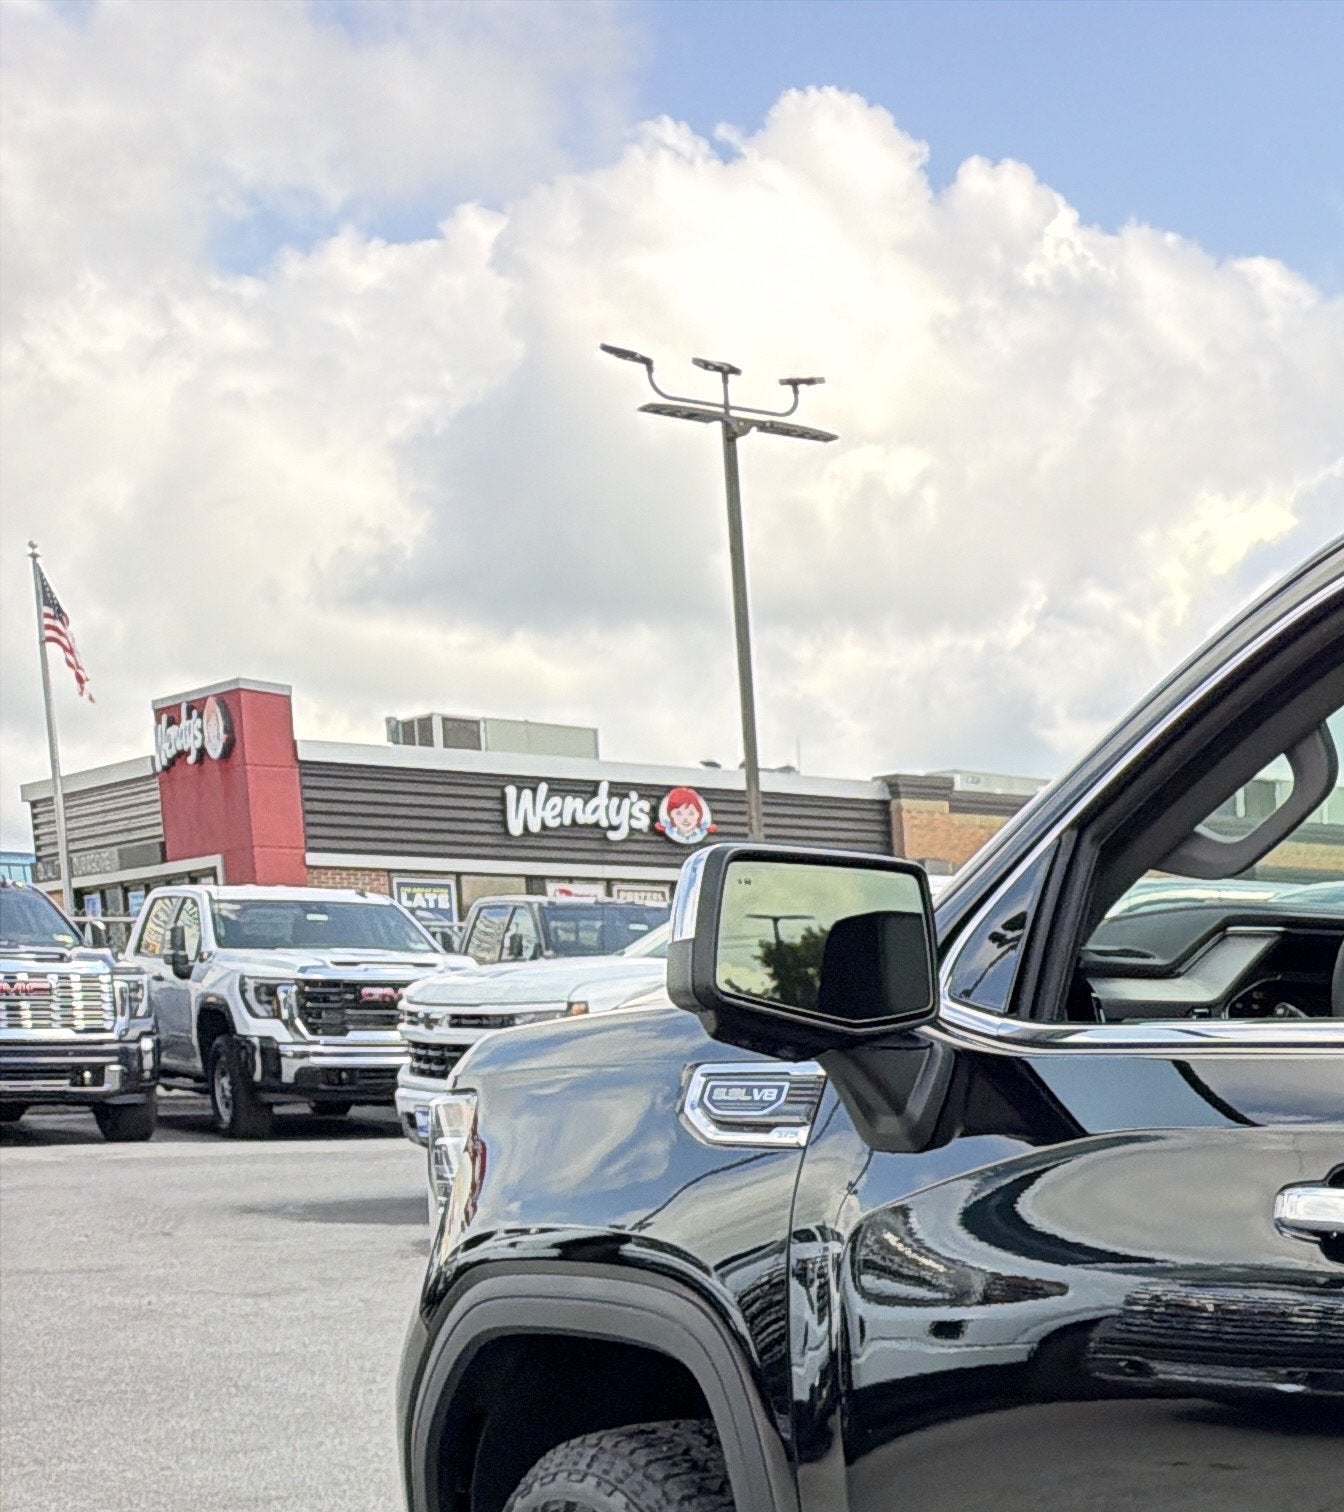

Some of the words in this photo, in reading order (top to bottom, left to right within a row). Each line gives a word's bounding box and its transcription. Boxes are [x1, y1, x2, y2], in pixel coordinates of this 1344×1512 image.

[155, 701, 203, 772] Wendy's
[504, 780, 650, 841] Wendy's
[401, 892, 450, 909] LATE
[361, 986, 405, 1002] GM
[753, 1087, 778, 1101] V8
